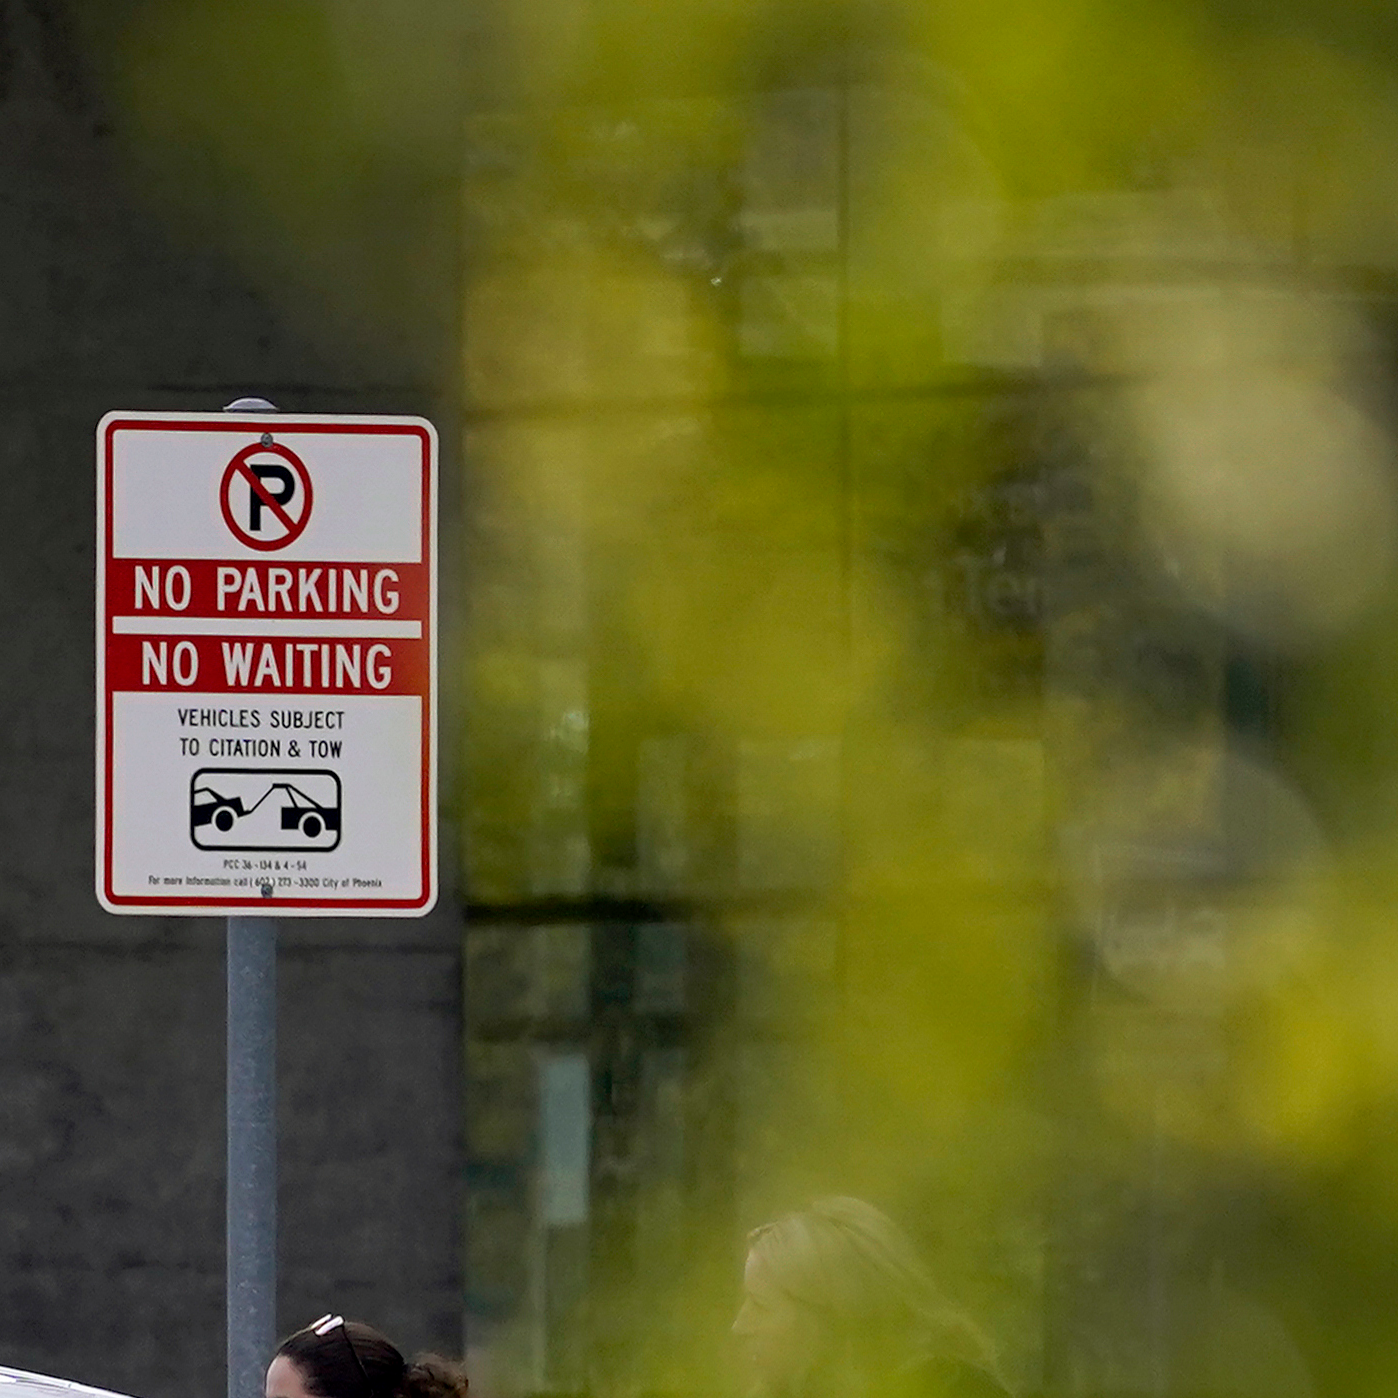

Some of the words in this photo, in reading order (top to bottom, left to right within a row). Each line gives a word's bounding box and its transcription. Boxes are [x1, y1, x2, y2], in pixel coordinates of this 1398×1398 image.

[134, 564, 192, 611] NO
[216, 566, 401, 615] PARKING
[141, 640, 199, 687] NO
[221, 641, 393, 690] WAITING
[177, 708, 261, 729] VEHICLES
[269, 710, 345, 730] SUBJECT
[179, 737, 200, 757] TO
[208, 738, 281, 758] CITATION
[287, 739, 301, 758] &
[308, 740, 343, 759] TOW
[352, 877, 382, 889] Phoenix
